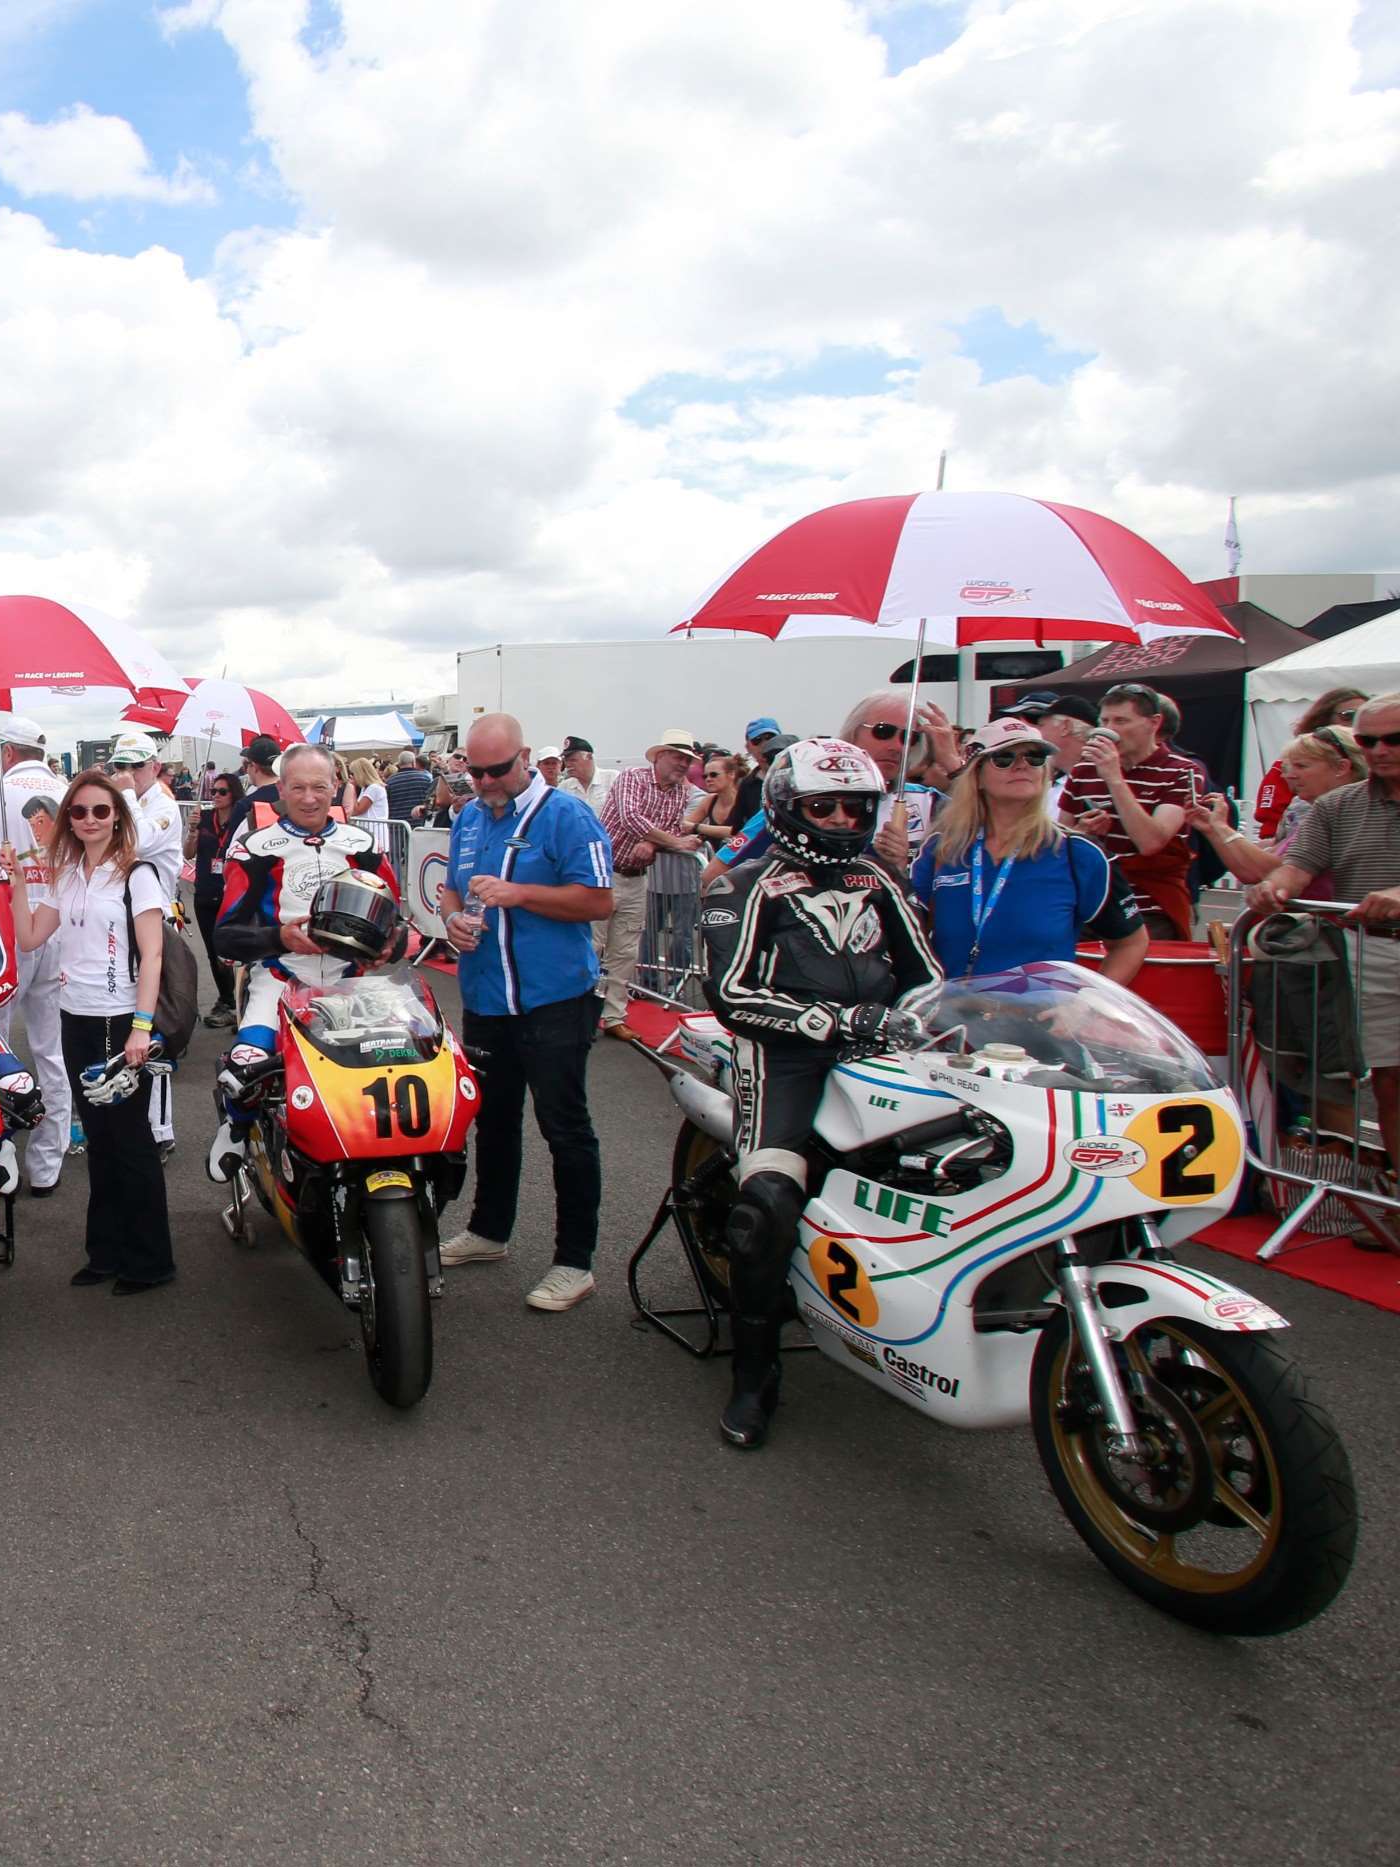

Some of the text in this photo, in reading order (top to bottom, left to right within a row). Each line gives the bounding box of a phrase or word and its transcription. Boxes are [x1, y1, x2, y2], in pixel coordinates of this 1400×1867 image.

[798, 591, 839, 600] LEGENDS
[264, 838, 288, 849] Arai
[843, 874, 881, 889] PHIL
[388, 1048, 420, 1058] DEKRA
[938, 1071, 981, 1093] PHIL READ
[362, 1075, 431, 1139] 10
[867, 1094, 902, 1112] LIFE
[1077, 1141, 1120, 1149] WORLD
[1156, 1103, 1217, 1199] 2
[1070, 1148, 1124, 1164] GP
[853, 1179, 956, 1239] LIFE
[827, 1240, 860, 1323] 2
[882, 1345, 960, 1399] Castrol
